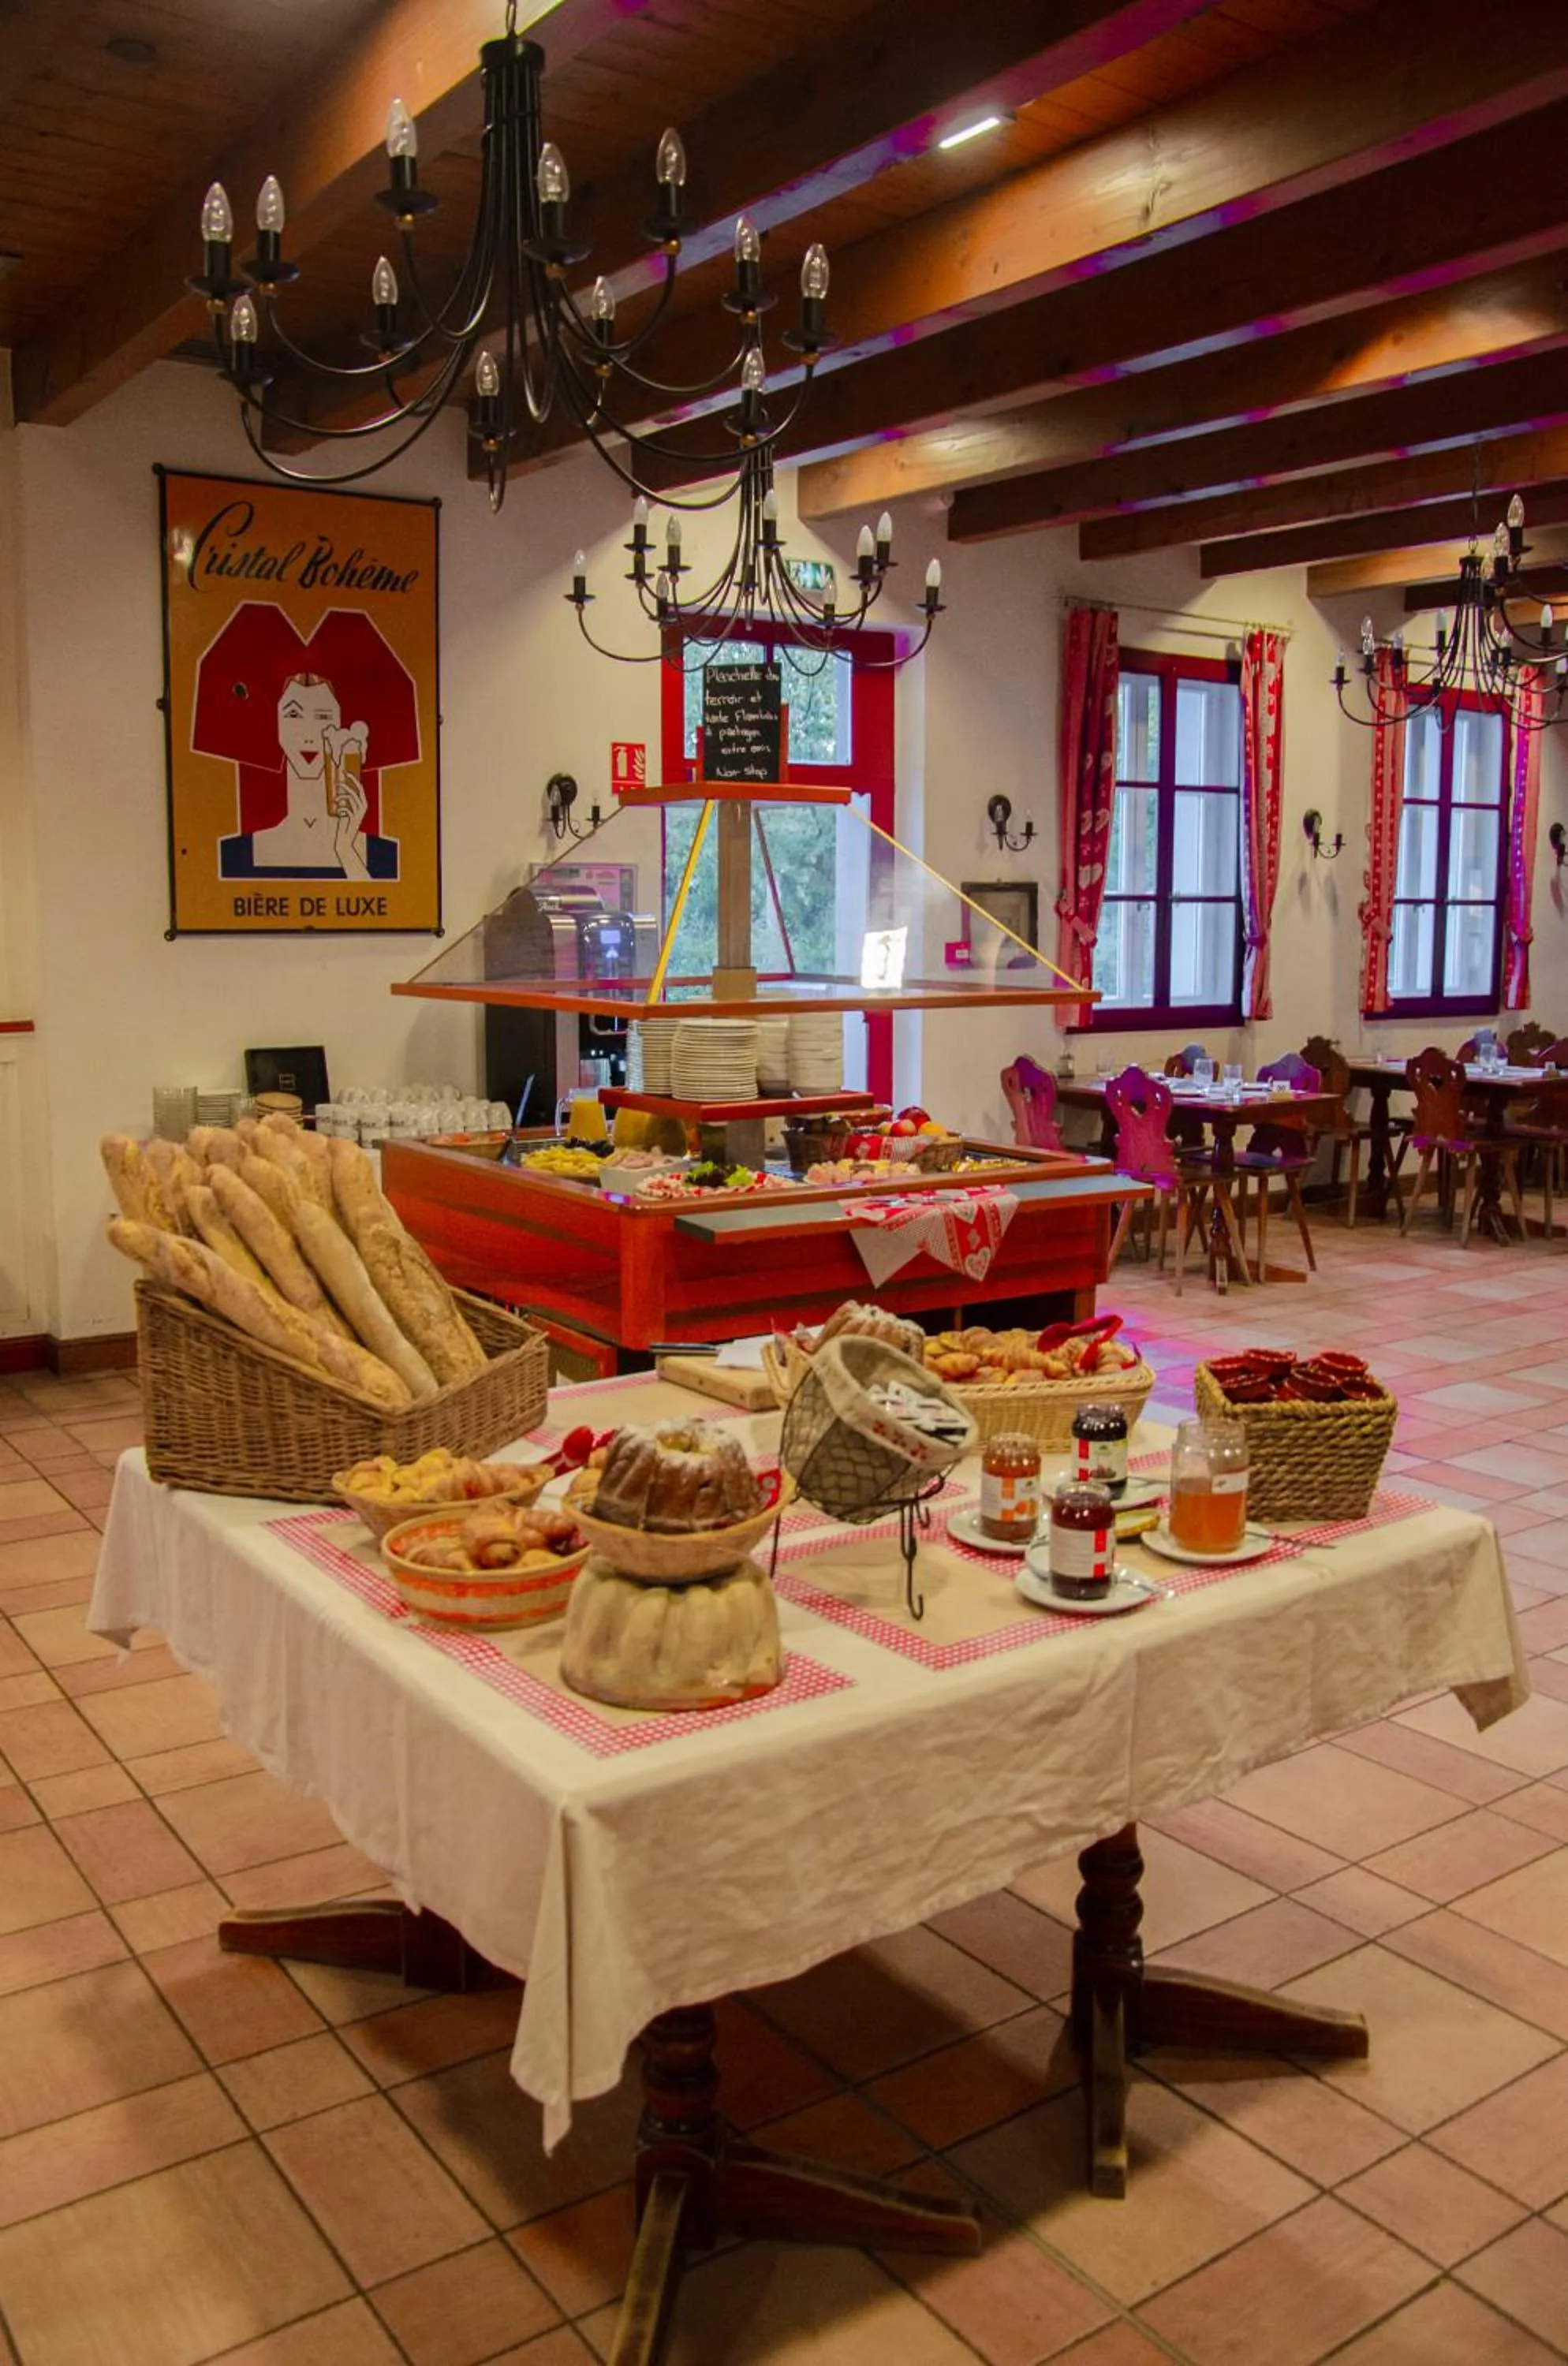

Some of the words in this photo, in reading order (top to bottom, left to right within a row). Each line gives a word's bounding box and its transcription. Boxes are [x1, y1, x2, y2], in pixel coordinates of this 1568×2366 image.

[187, 500, 306, 592] Cristal
[233, 892, 289, 916] BIÈRE
[300, 897, 327, 916] DE
[335, 897, 387, 916] LUXE
